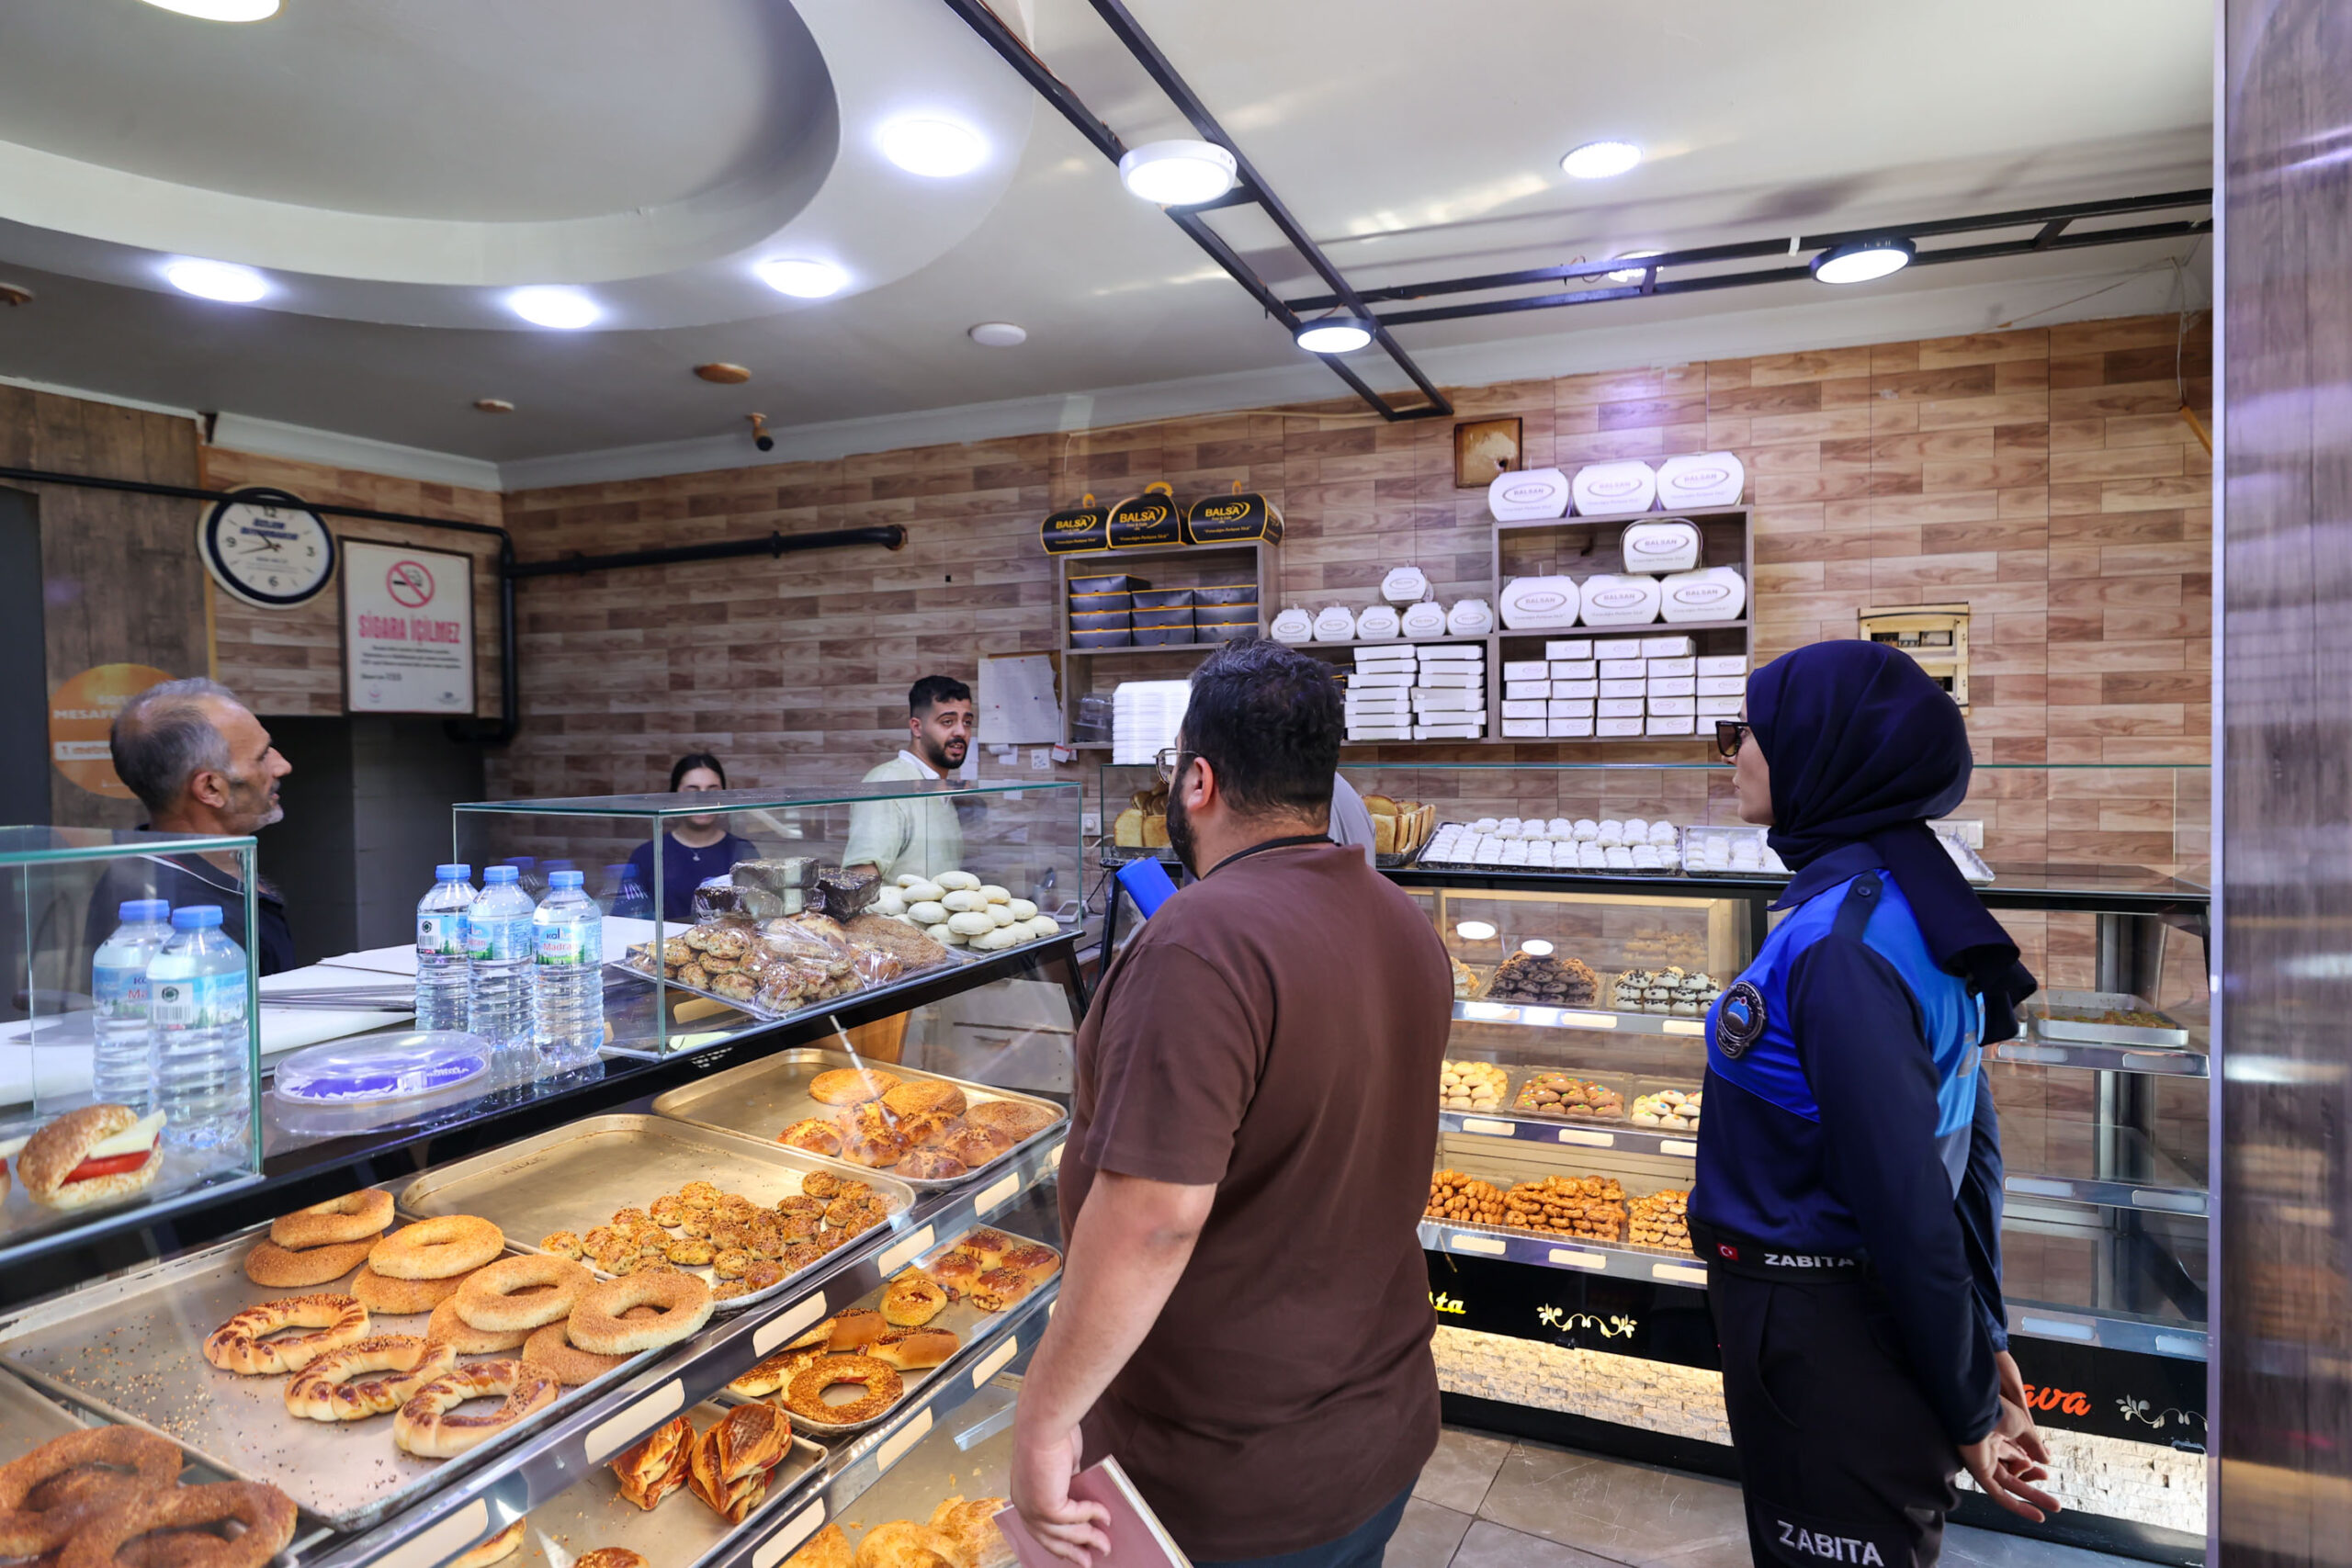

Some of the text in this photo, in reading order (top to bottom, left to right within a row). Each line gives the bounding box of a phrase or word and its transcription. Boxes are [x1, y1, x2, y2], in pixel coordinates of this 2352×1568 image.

[1514, 488, 1544, 497] BALSAN
[1120, 511, 1156, 523] BALSA
[1204, 507, 1239, 517] BALSA
[1056, 519, 1088, 529] BALSA
[1645, 538, 1677, 547] BALSAN
[1603, 592, 1635, 602] BALSAN
[1685, 588, 1719, 597] BALSAN
[1525, 596, 1556, 604] BALSAN
[358, 610, 461, 646] SİGARA İÇİLMEZ
[1764, 1253, 1855, 1268] ZABITA
[1777, 1519, 1885, 1567] ZABITA
